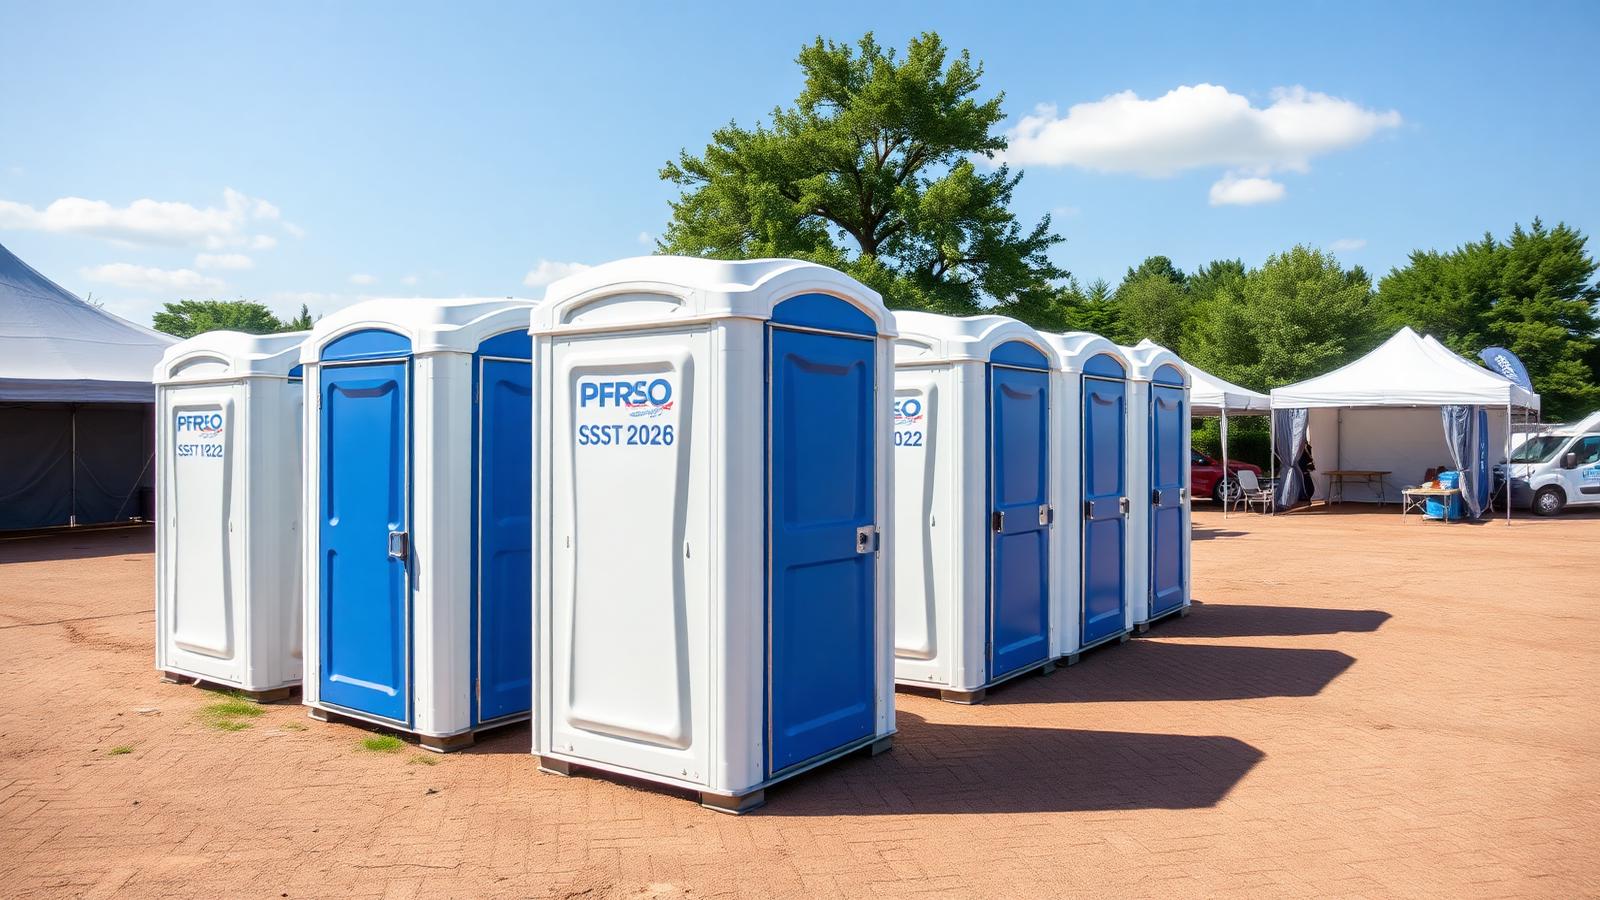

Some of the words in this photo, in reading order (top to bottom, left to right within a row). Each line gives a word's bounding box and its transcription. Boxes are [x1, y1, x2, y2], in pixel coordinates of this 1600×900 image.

[580, 378, 673, 408] PFRSO
[578, 424, 623, 446] SSST
[626, 424, 674, 446] 2026
